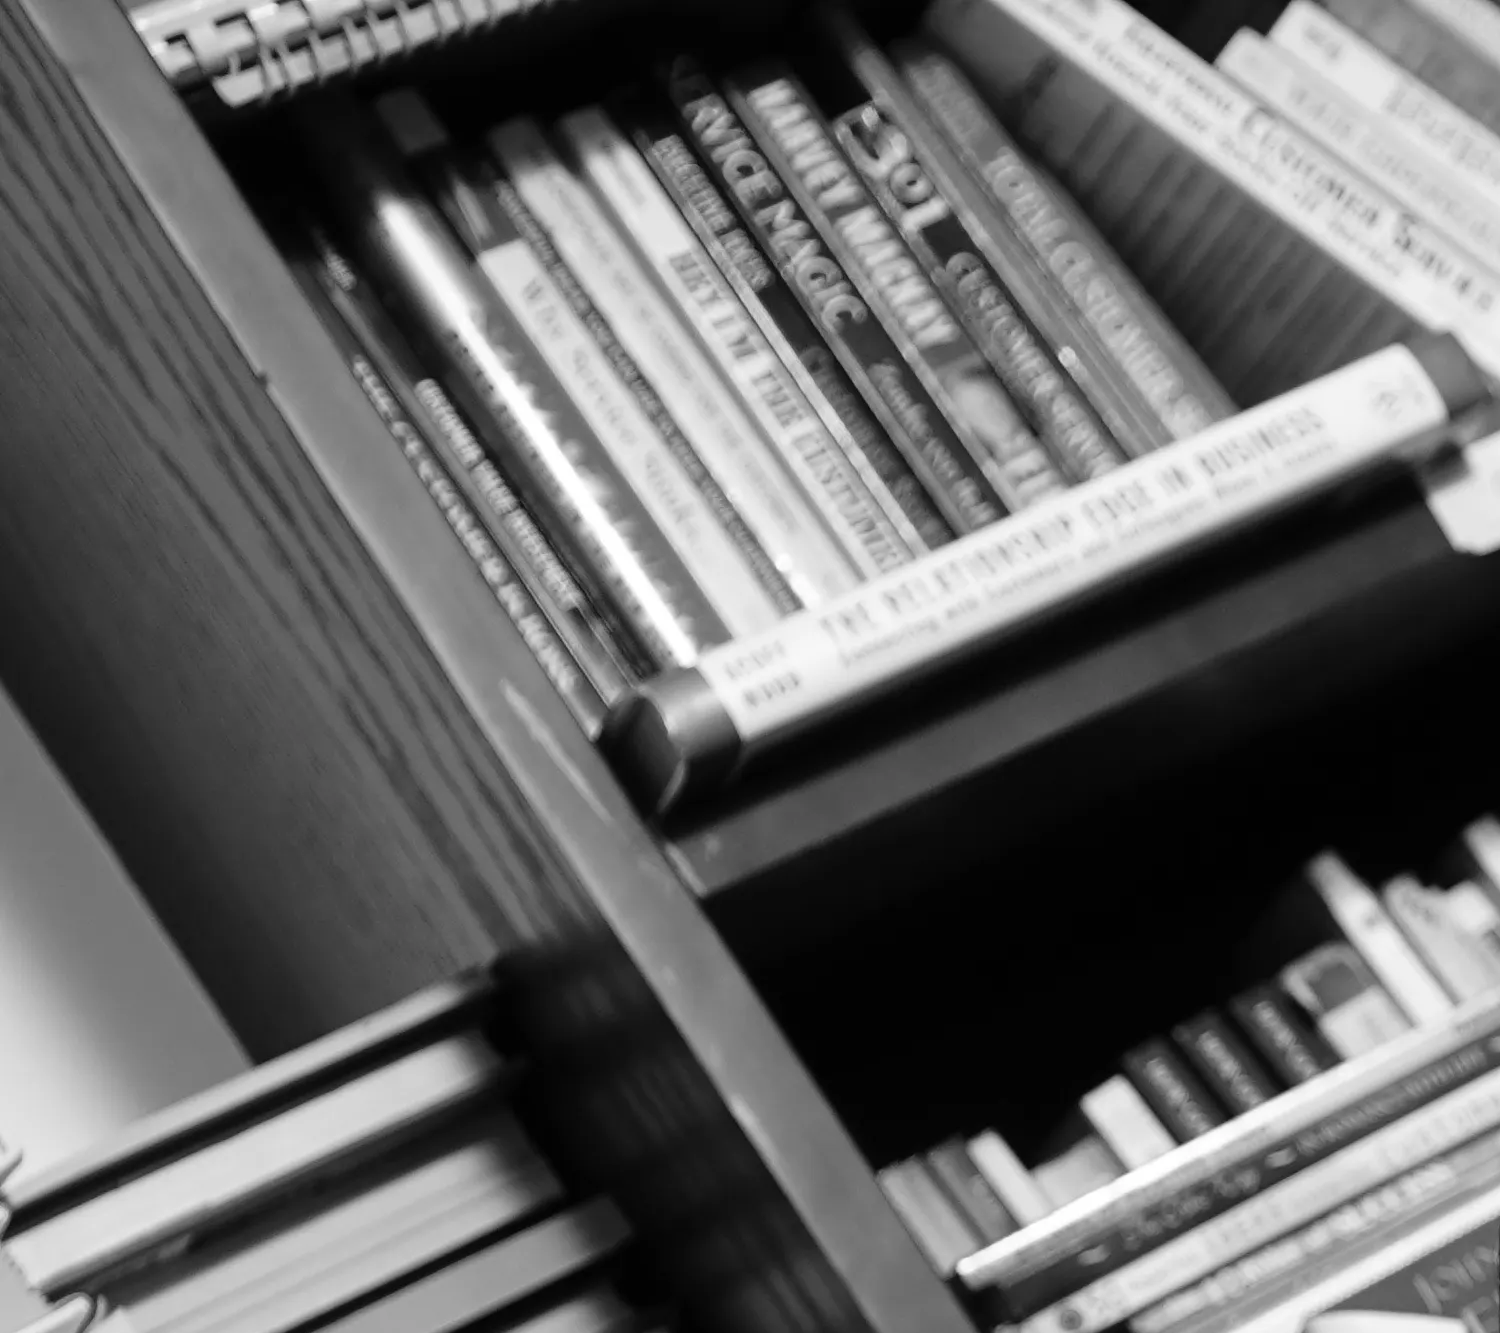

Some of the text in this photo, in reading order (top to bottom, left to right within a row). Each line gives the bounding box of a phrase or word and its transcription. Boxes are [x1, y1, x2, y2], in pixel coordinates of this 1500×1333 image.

[744, 70, 865, 219] HARVEY
[831, 197, 962, 361] MACKAY
[751, 192, 870, 340] MAGIC
